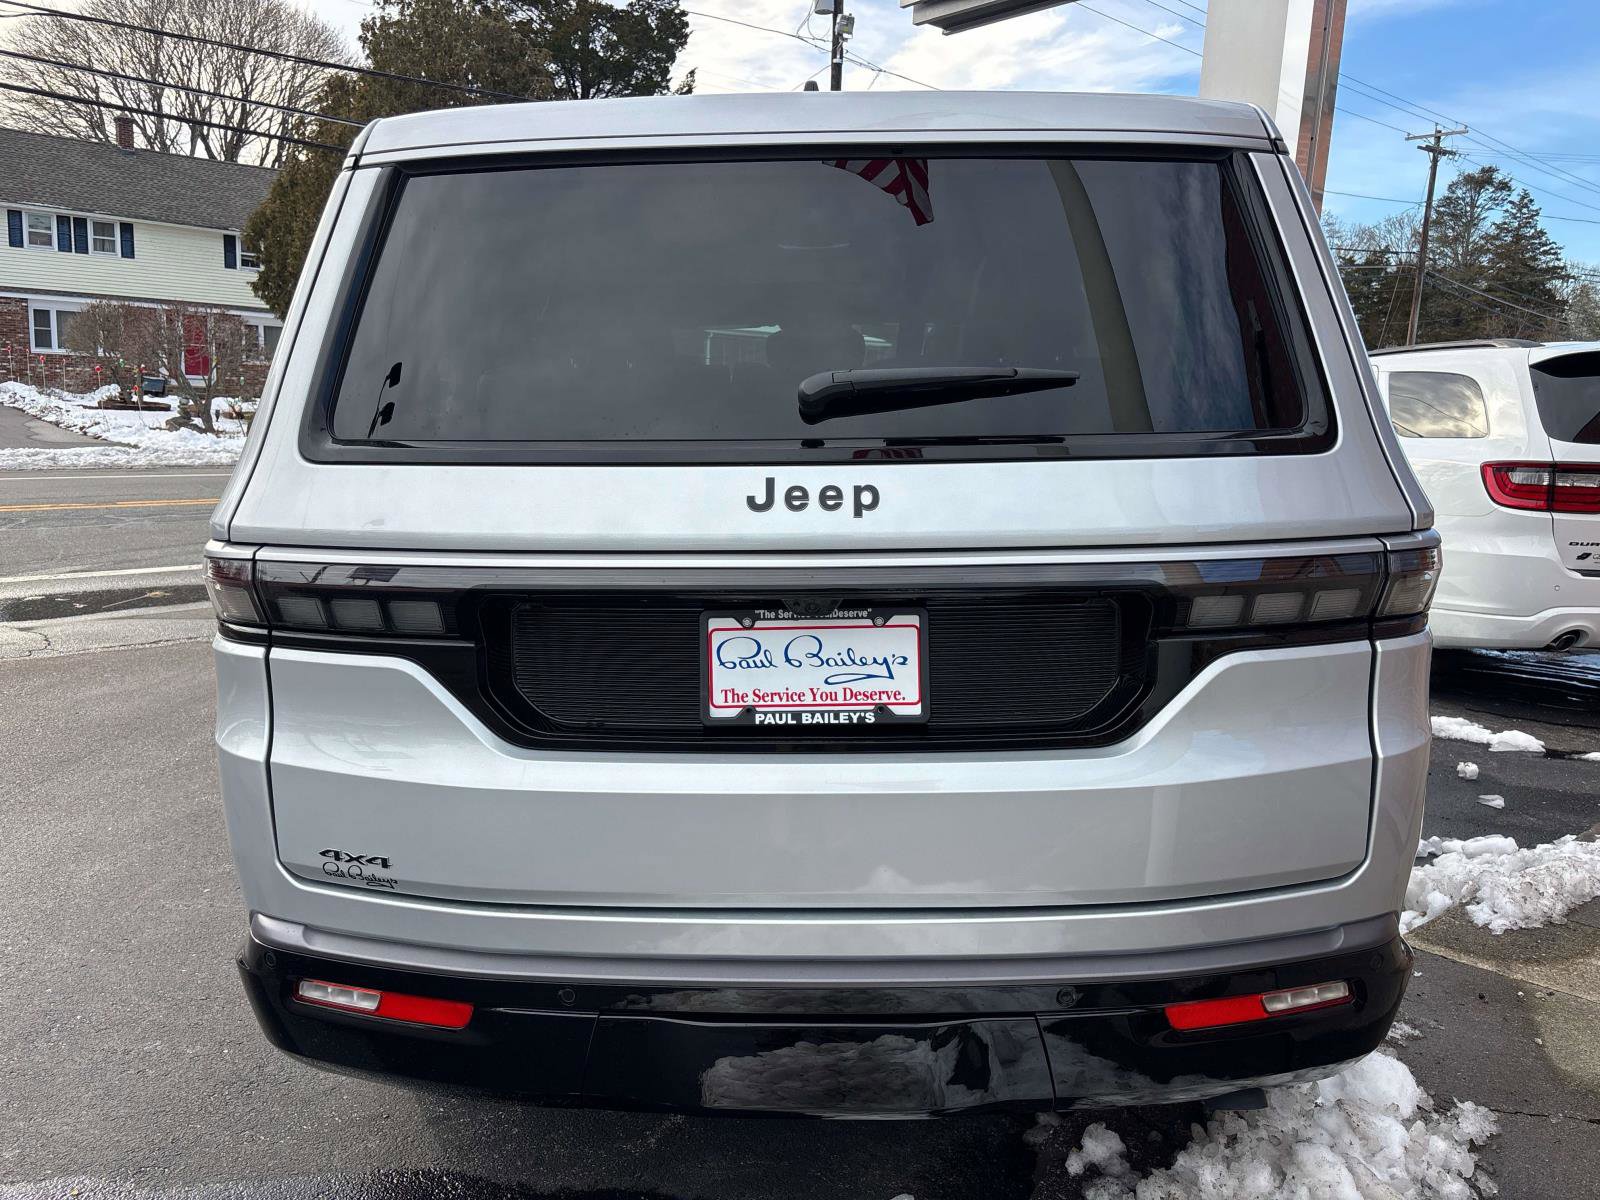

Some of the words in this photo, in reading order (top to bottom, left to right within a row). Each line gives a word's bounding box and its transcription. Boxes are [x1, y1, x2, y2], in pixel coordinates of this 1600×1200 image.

[746, 477, 880, 518] Jeep
[716, 636, 779, 670] Paul
[783, 634, 909, 686] Bailey's
[720, 688, 750, 704] The
[752, 686, 806, 703] Service
[809, 687, 838, 702] You
[842, 687, 906, 702] Deserve.
[755, 713, 797, 725] PAUL
[801, 712, 876, 724] BAILEY'S
